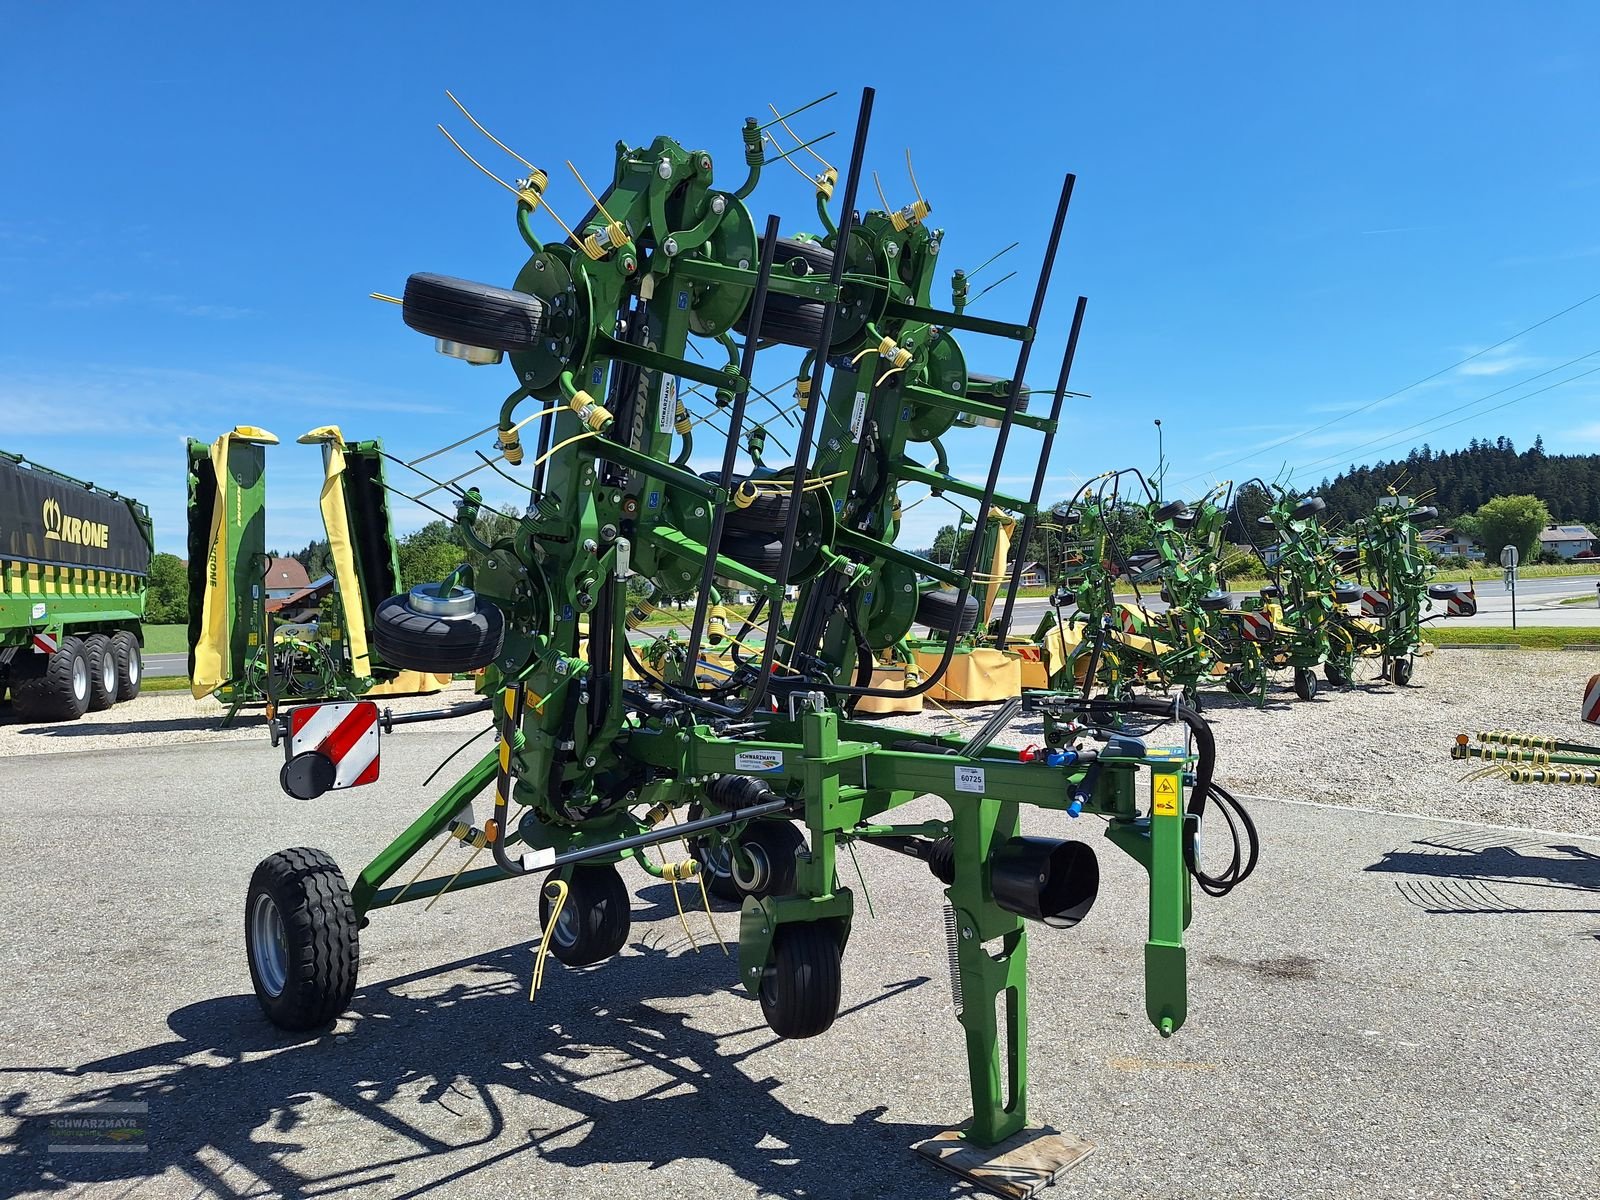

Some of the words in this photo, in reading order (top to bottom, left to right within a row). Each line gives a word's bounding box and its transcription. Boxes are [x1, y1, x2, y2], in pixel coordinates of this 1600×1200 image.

[660, 381, 671, 428] SCHWARZMAYR
[61, 514, 109, 549] KRONE
[739, 753, 776, 761] SCHWARZMAYR
[960, 774, 982, 783] 60725
